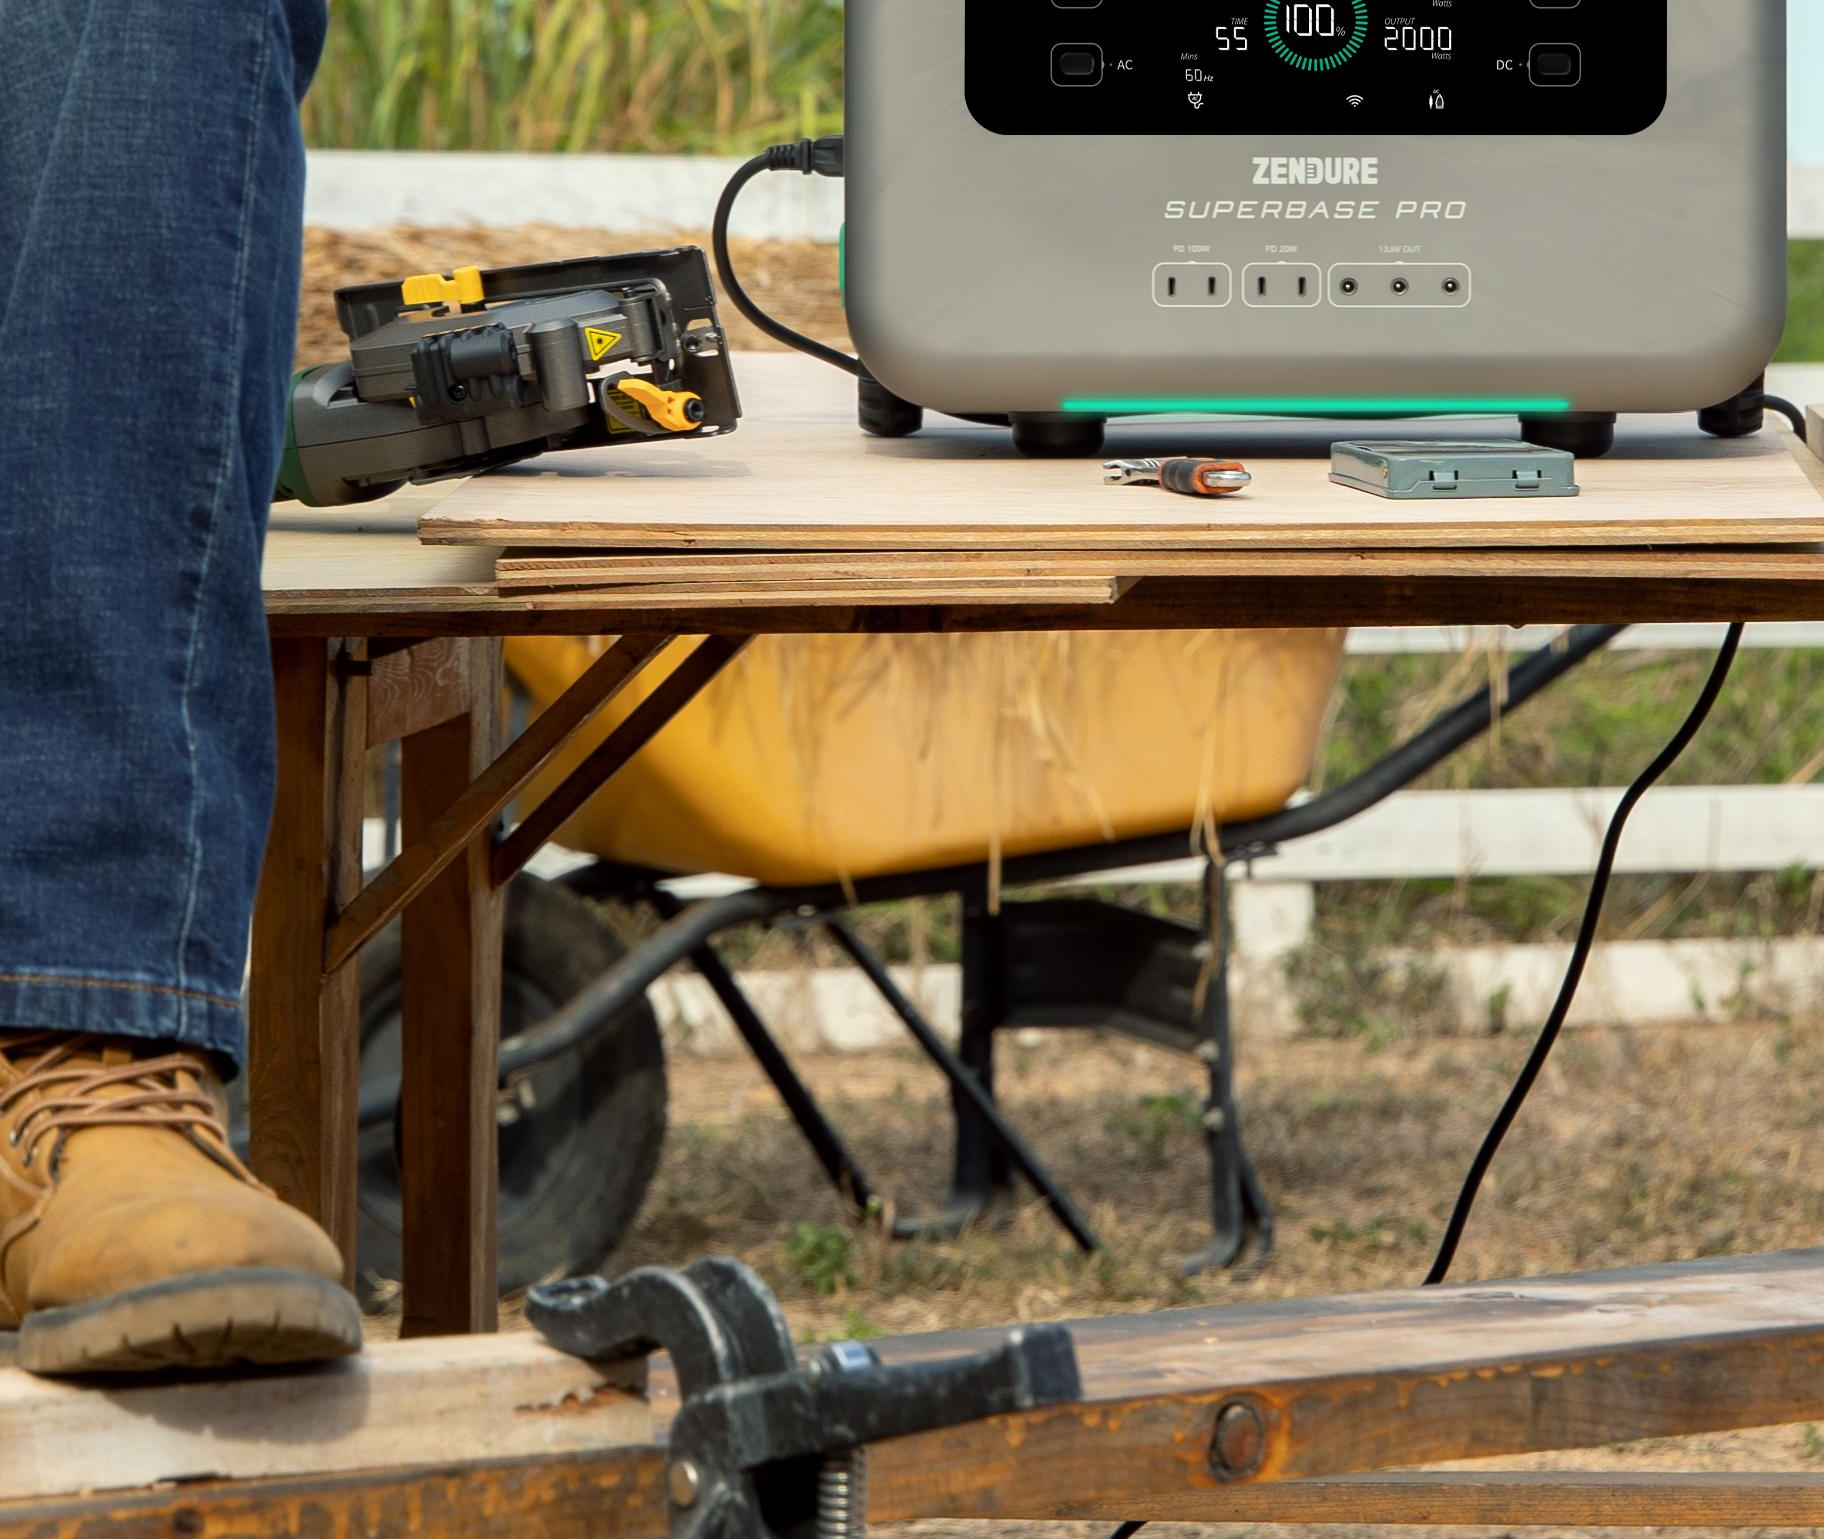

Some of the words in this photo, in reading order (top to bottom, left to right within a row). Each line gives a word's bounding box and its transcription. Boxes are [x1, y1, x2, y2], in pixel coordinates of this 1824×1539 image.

[1432, 0, 1453, 8] Watts
[1231, 17, 1248, 26] TIME
[1384, 17, 1416, 26] OUTPUT
[1216, 27, 1247, 50] 55
[1385, 27, 1451, 50] 2000
[1180, 52, 1198, 61] Mins
[1116, 59, 1133, 71] AC
[1496, 59, 1513, 71] DC
[1253, 158, 1377, 184] ZENDURE
[1164, 200, 1380, 219] SUPERBASE
[1395, 200, 1467, 219] PRO
